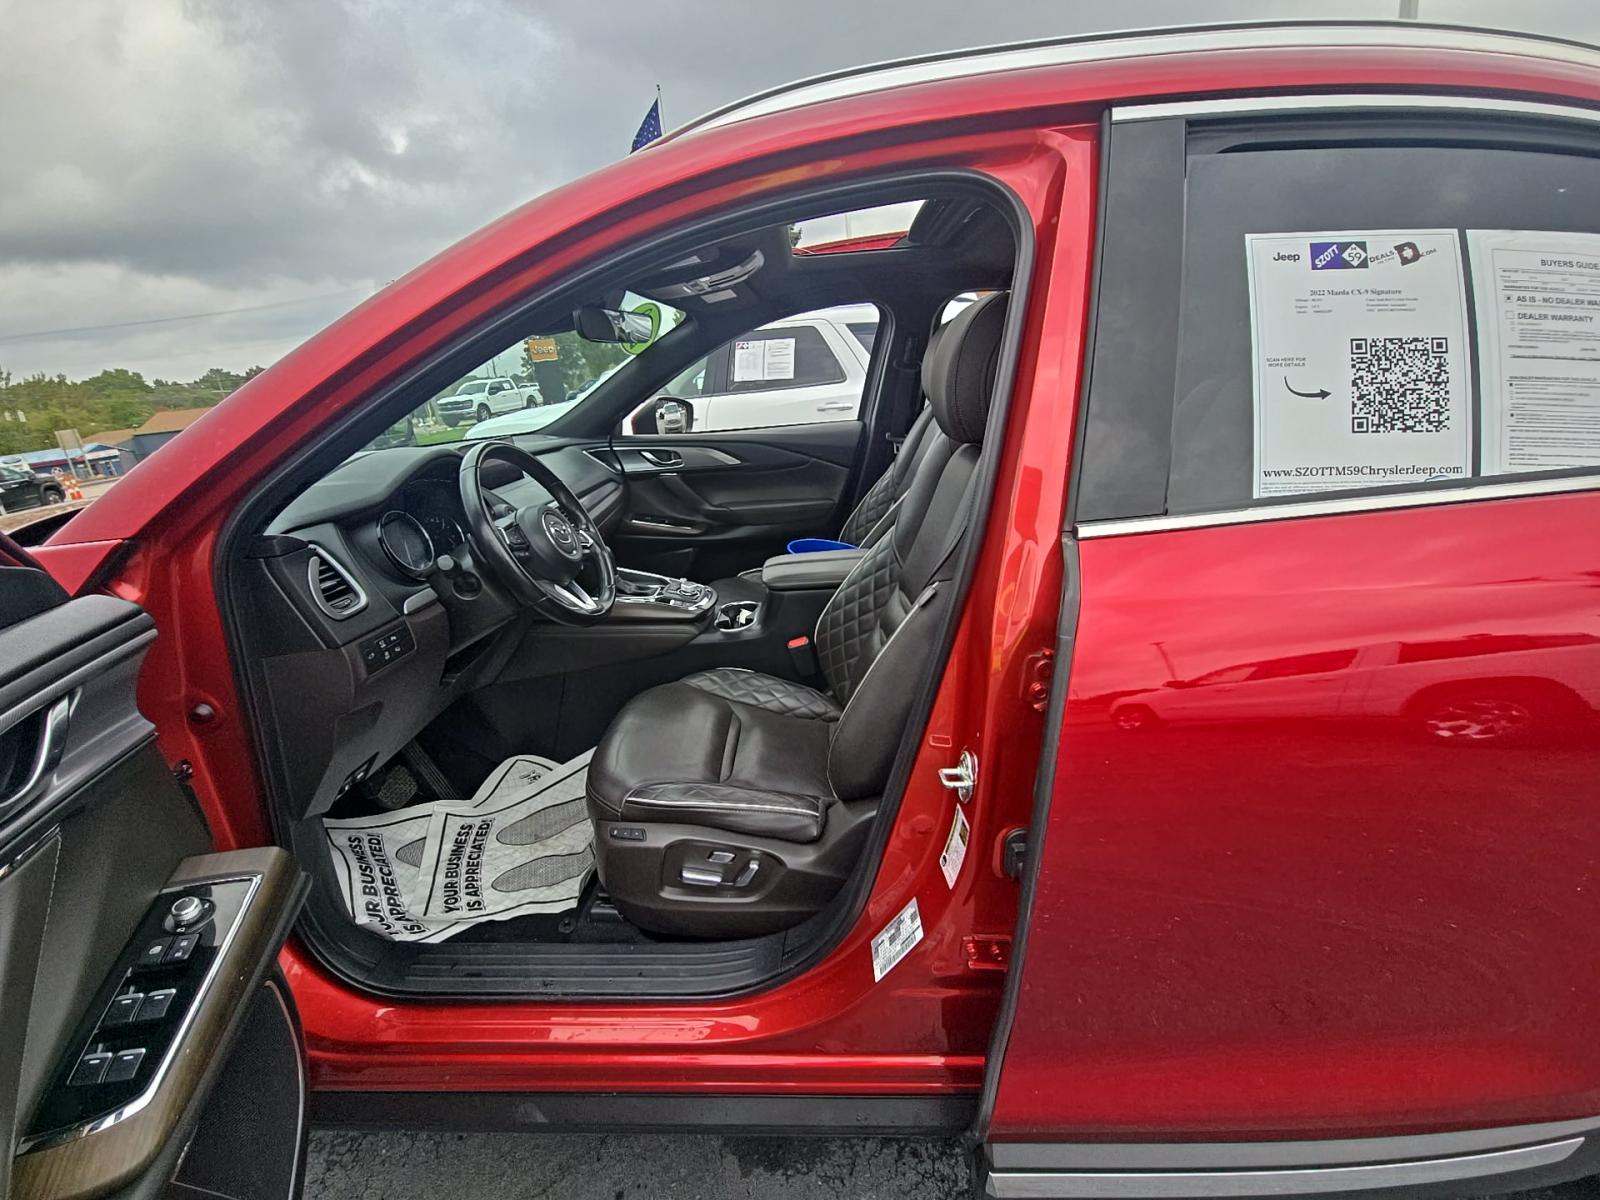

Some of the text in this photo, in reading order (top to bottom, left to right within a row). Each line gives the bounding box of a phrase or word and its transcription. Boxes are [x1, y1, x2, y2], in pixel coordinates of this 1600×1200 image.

[1273, 252, 1300, 262] Jeep
[1314, 243, 1339, 268] SZOTT
[1348, 252, 1362, 262] 59
[1369, 250, 1395, 263] DEALS
[1540, 259, 1600, 270] BUYERS GUIDE
[1516, 295, 1527, 303] AS
[1555, 297, 1585, 305] DEALER
[1517, 312, 1593, 323] DEALER WARRANTY
[1263, 464, 1463, 478] www.SZOTTM59ChryslerJeep.com
[348, 836, 379, 896] BUSINESS
[443, 823, 473, 913] YOUR BUSINESS
[464, 819, 493, 912] IS APPRECIATED!
